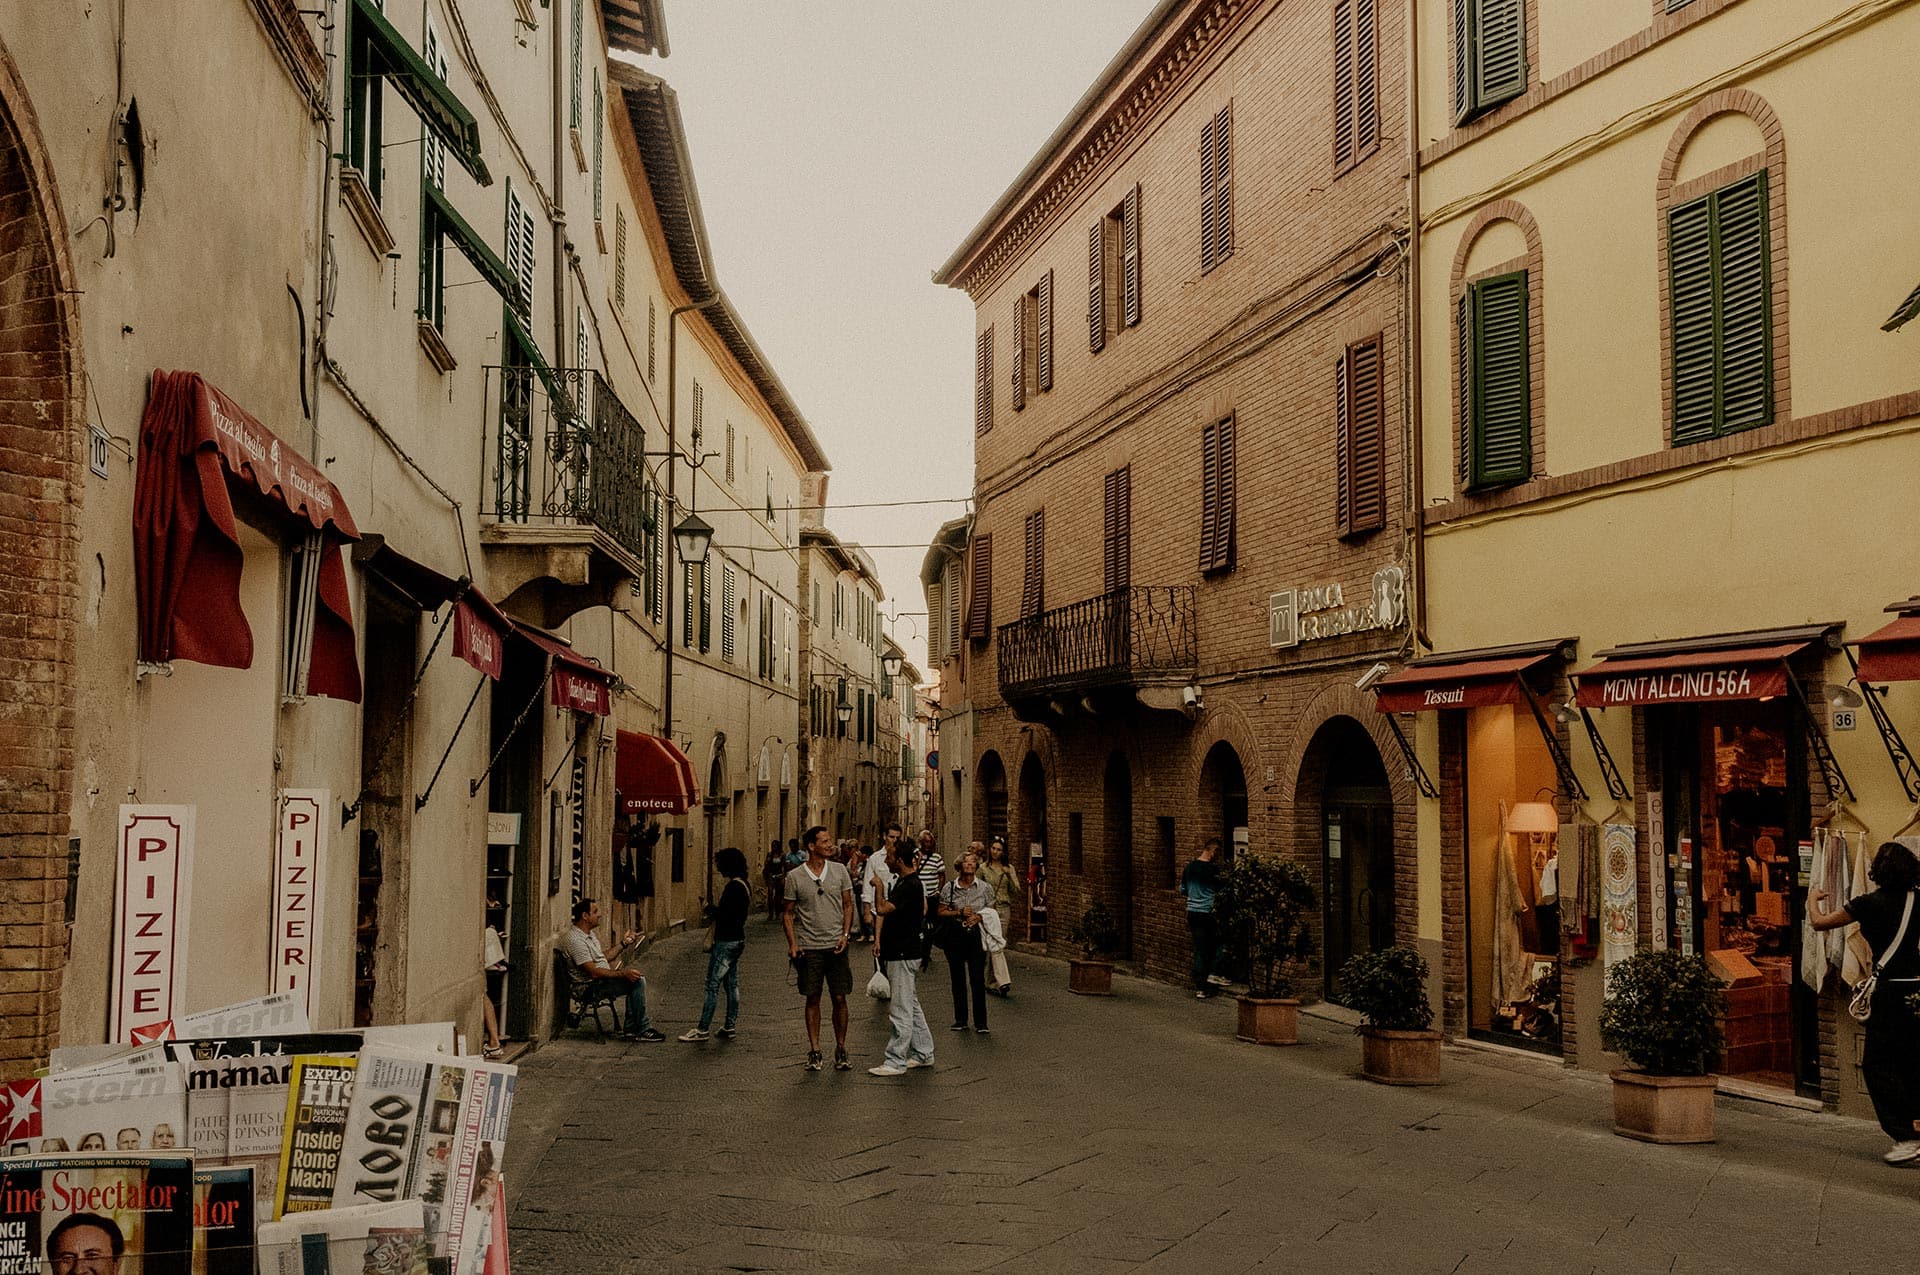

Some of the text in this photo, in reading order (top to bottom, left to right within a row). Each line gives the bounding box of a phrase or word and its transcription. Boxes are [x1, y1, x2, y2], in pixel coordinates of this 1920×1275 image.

[210, 400, 266, 461] Pizza al taglio
[94, 436, 106, 467] 10
[290, 466, 307, 494] Pizza
[314, 486, 334, 510] taglio
[1423, 685, 1465, 705] Tessuti
[1602, 672, 1713, 702] MONTALCINO
[1836, 713, 1852, 727] 36
[627, 798, 674, 809] enoteca
[1650, 797, 1666, 944] enoteca
[284, 813, 310, 990] PIZZERI
[133, 838, 167, 1014] PIZZE
[189, 1001, 294, 1037] stern
[52, 1076, 167, 1110] stern
[295, 1129, 343, 1150] Inside
[3, 1159, 151, 1171] Special Issue: MATCHING WINE AND FOOD
[0, 1170, 178, 1215] ine Spectator
